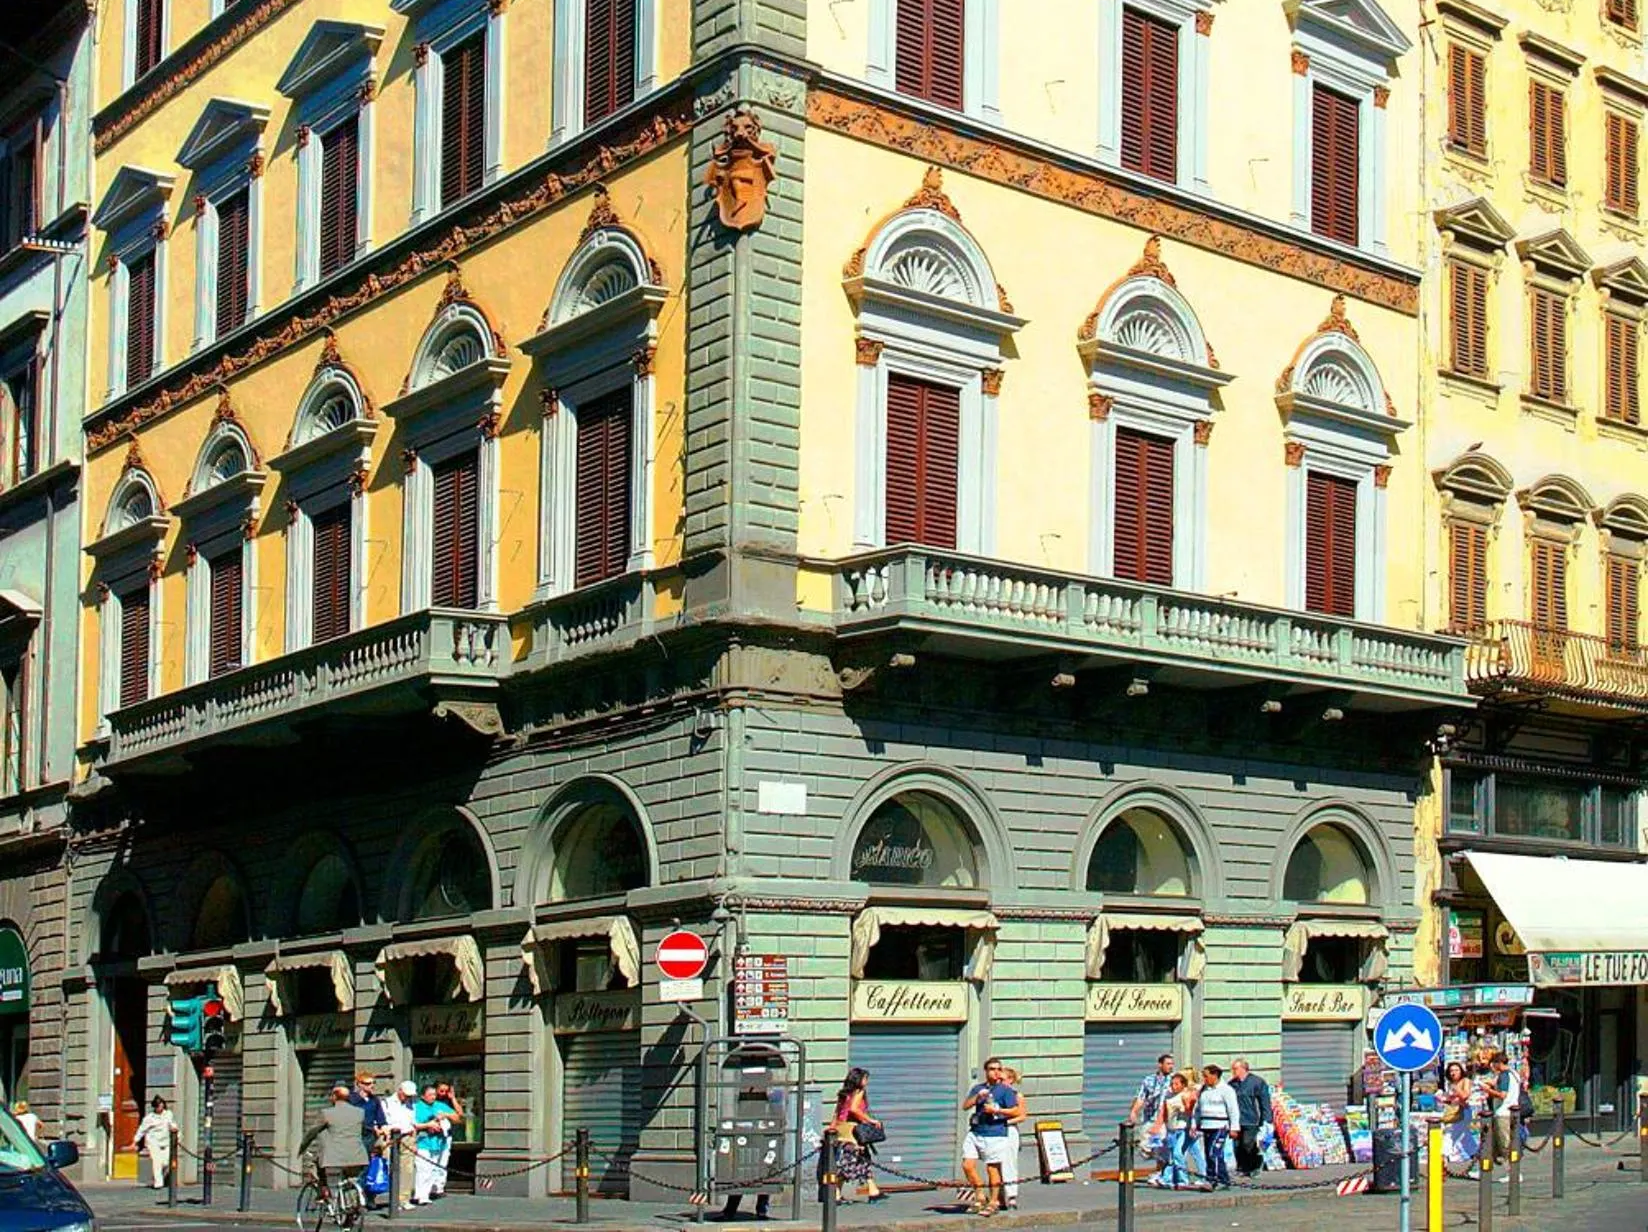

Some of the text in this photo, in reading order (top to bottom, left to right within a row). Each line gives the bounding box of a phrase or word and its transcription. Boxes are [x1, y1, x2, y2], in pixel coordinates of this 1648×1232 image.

[1585, 955, 1600, 981] LE
[1605, 955, 1628, 982] TUE
[867, 985, 952, 1016] Caffetteria
[1094, 988, 1172, 1016] Self Service
[1289, 991, 1354, 1013] Snack Bar
